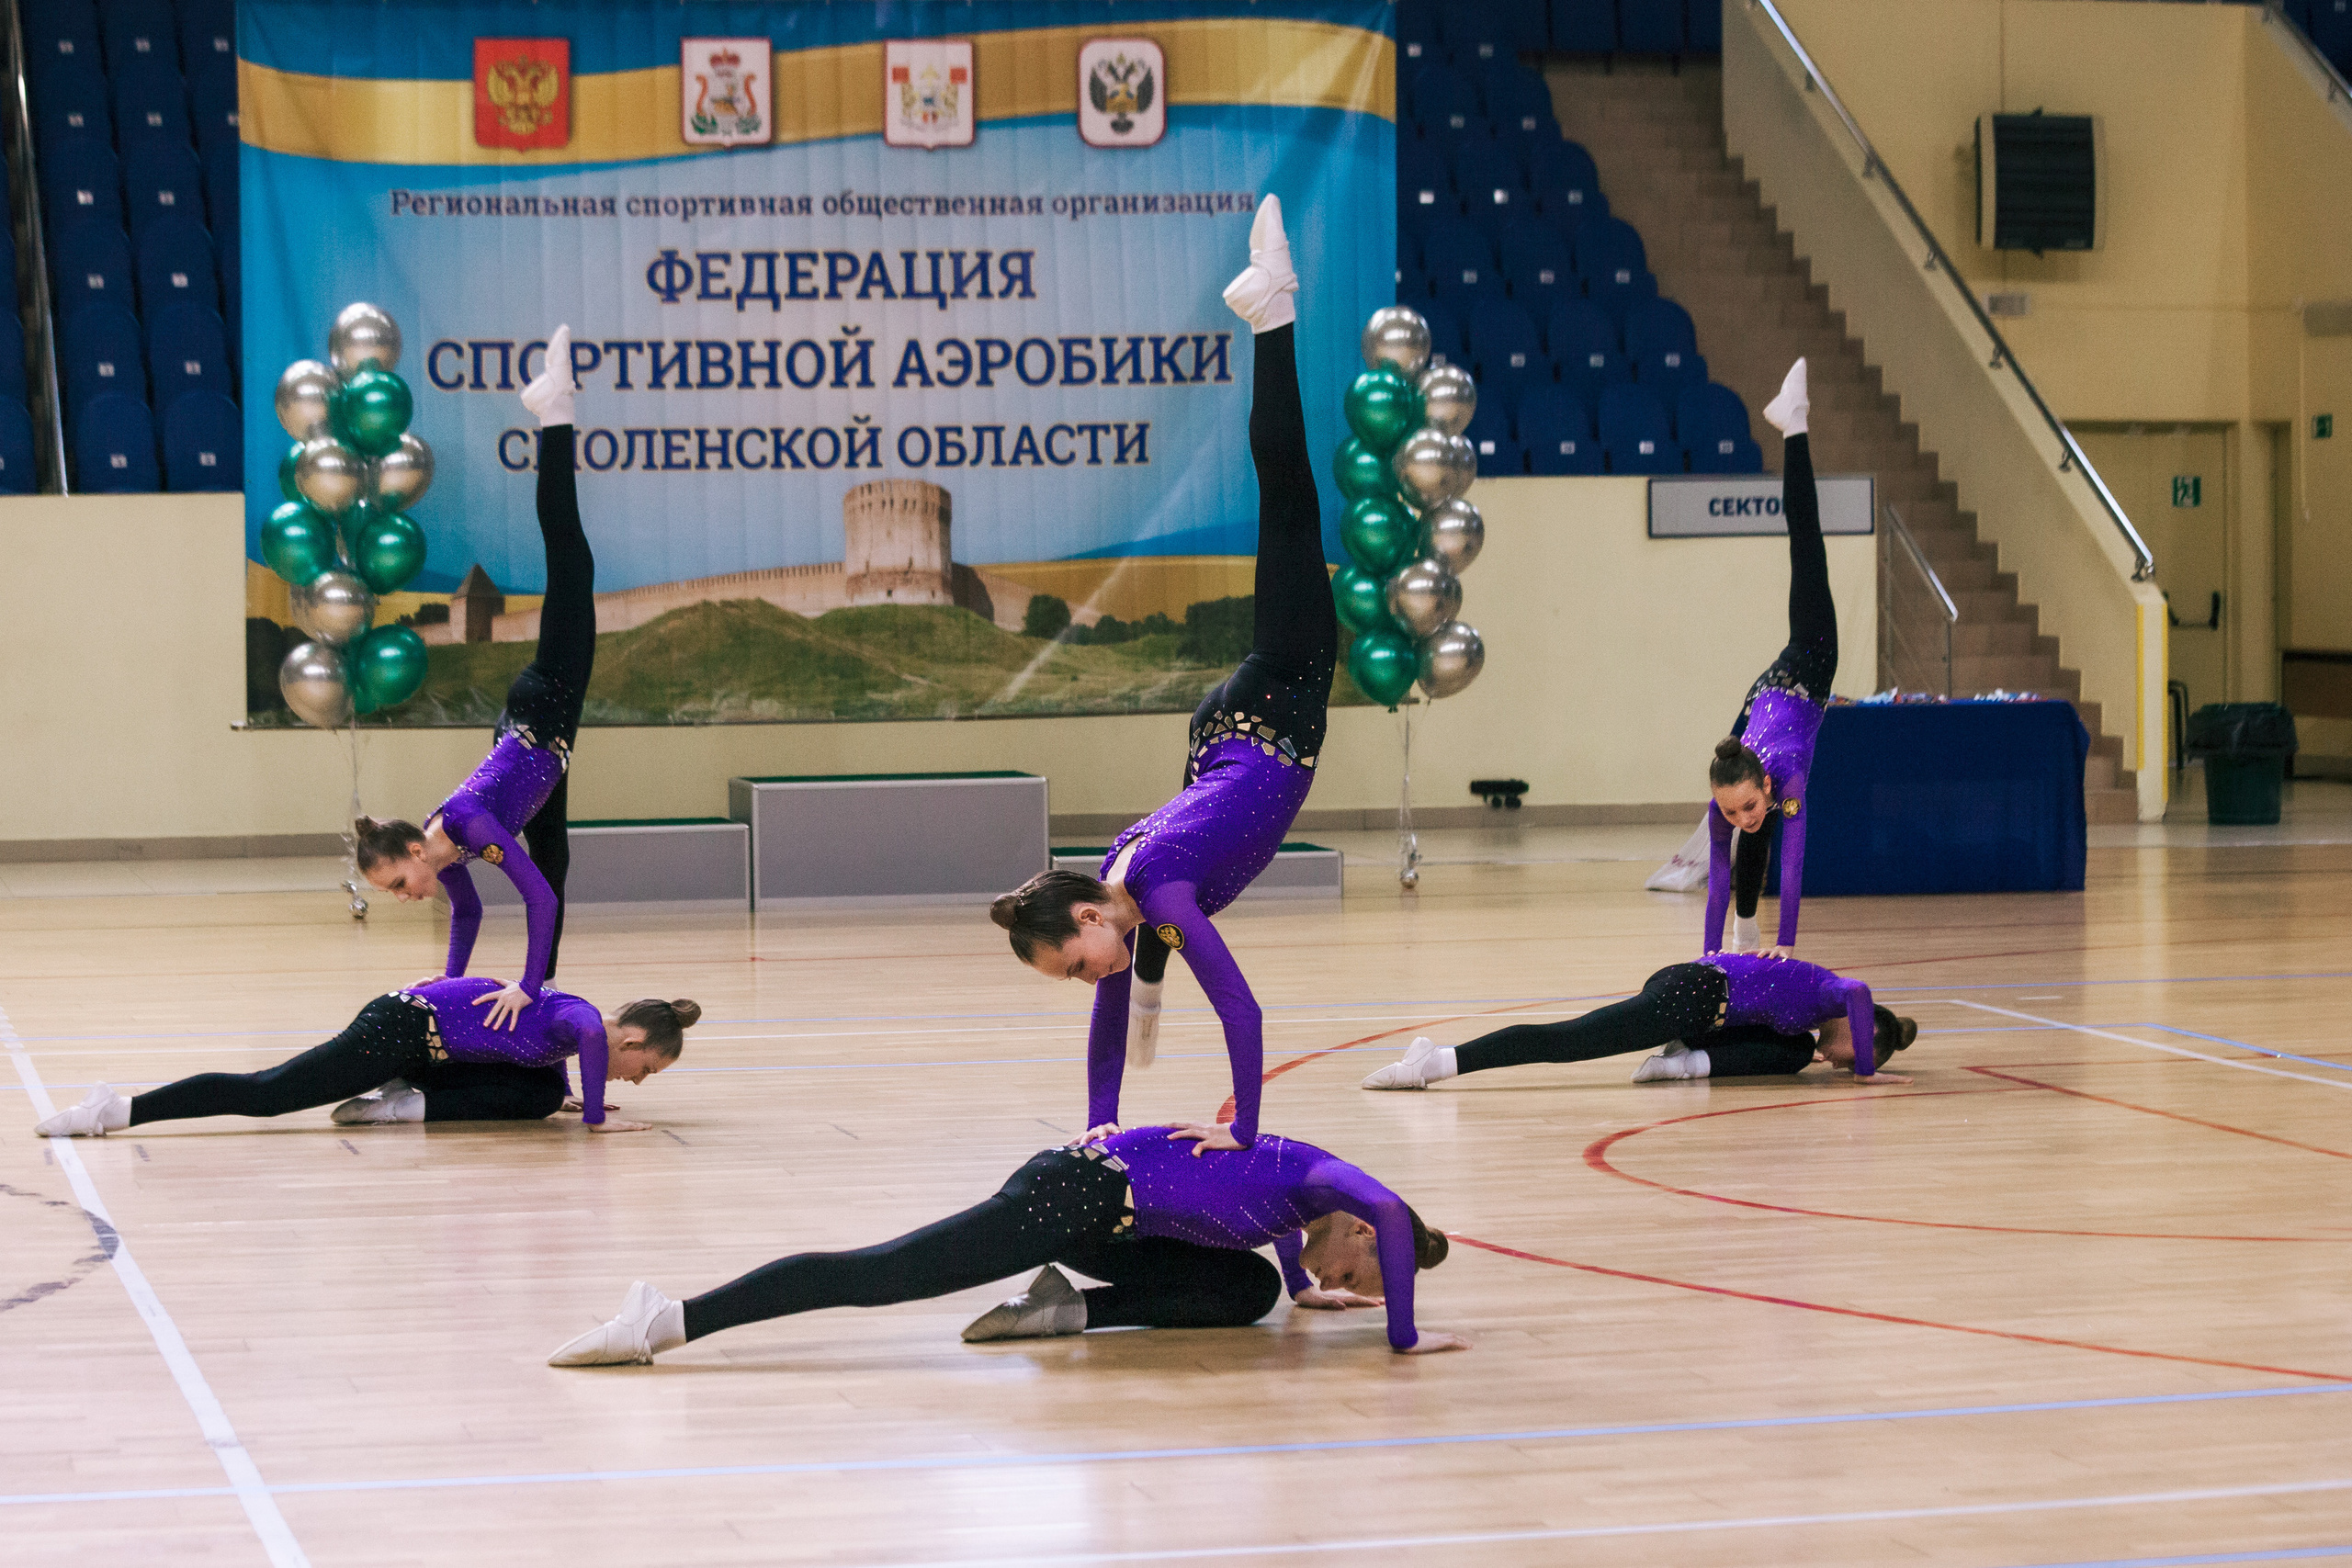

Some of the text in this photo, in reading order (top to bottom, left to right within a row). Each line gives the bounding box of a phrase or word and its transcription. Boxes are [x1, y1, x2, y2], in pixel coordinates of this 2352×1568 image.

[390, 188, 1255, 221] Региональная спортивная общественная организация
[647, 250, 1035, 310] ФЕДЕРАЦИЯ
[892, 334, 1232, 387] АЭРОБИКИ
[897, 423, 1151, 468] ОБЛАСТИ
[1709, 497, 1786, 516] СЕКТО
